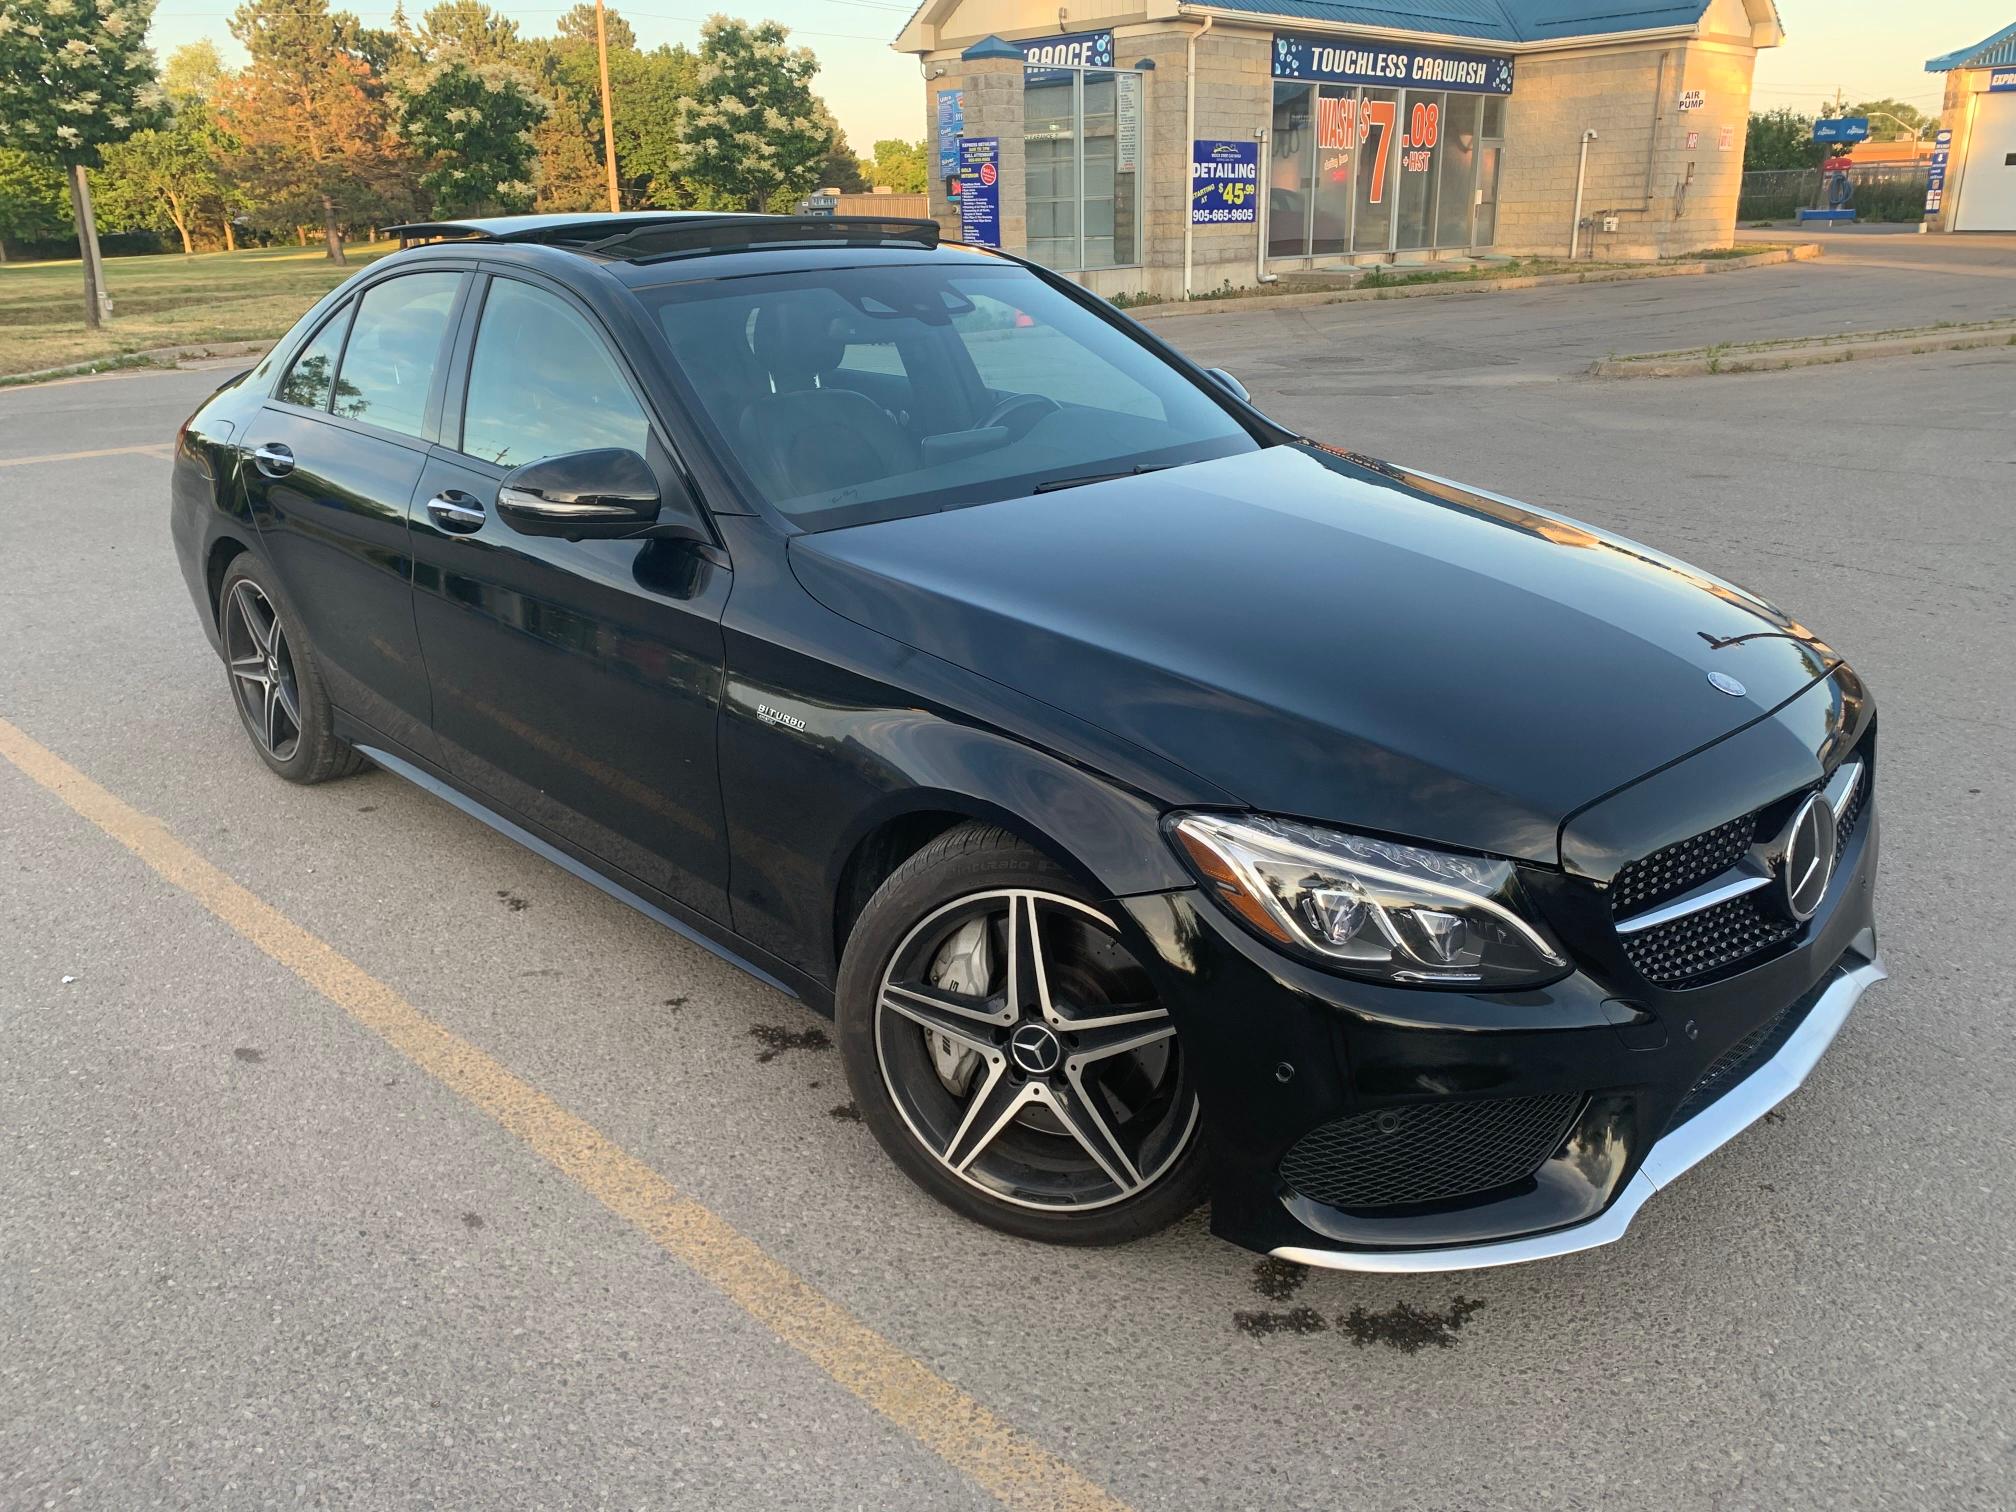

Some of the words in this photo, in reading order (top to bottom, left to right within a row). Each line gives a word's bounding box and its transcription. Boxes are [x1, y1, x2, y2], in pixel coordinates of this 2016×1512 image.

[1023, 42, 1093, 73] RANCE
[1311, 47, 1408, 79] TOUCHLESS
[1412, 57, 1487, 84] CARWASH
[1679, 100, 1704, 109] PUMP
[1685, 91, 1700, 99] AIR
[1318, 97, 1356, 149] WASH
[1192, 163, 1256, 179] DETAILING
[1192, 208, 1254, 221] 905-665-9605
[758, 704, 806, 729] BITURBO
